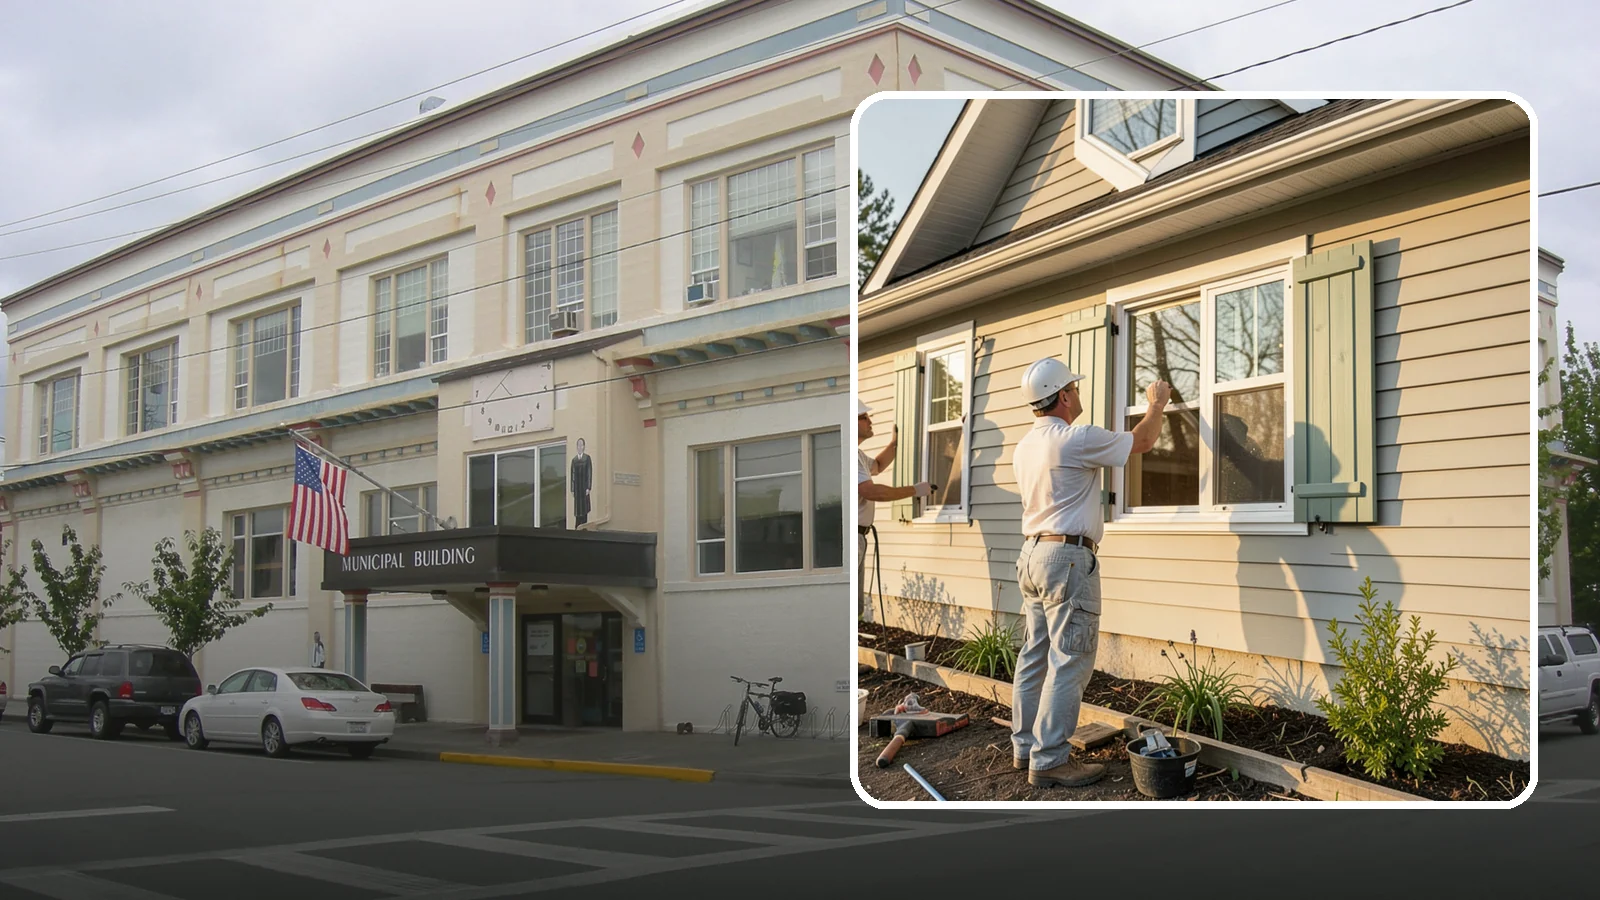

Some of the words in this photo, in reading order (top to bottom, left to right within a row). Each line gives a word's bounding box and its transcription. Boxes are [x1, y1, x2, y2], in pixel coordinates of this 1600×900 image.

[475, 390, 479, 398] 7
[480, 407, 485, 415] 8
[529, 414, 532, 422] 3
[342, 552, 405, 572] MUNICIPAL
[414, 547, 475, 567] BUILDING
